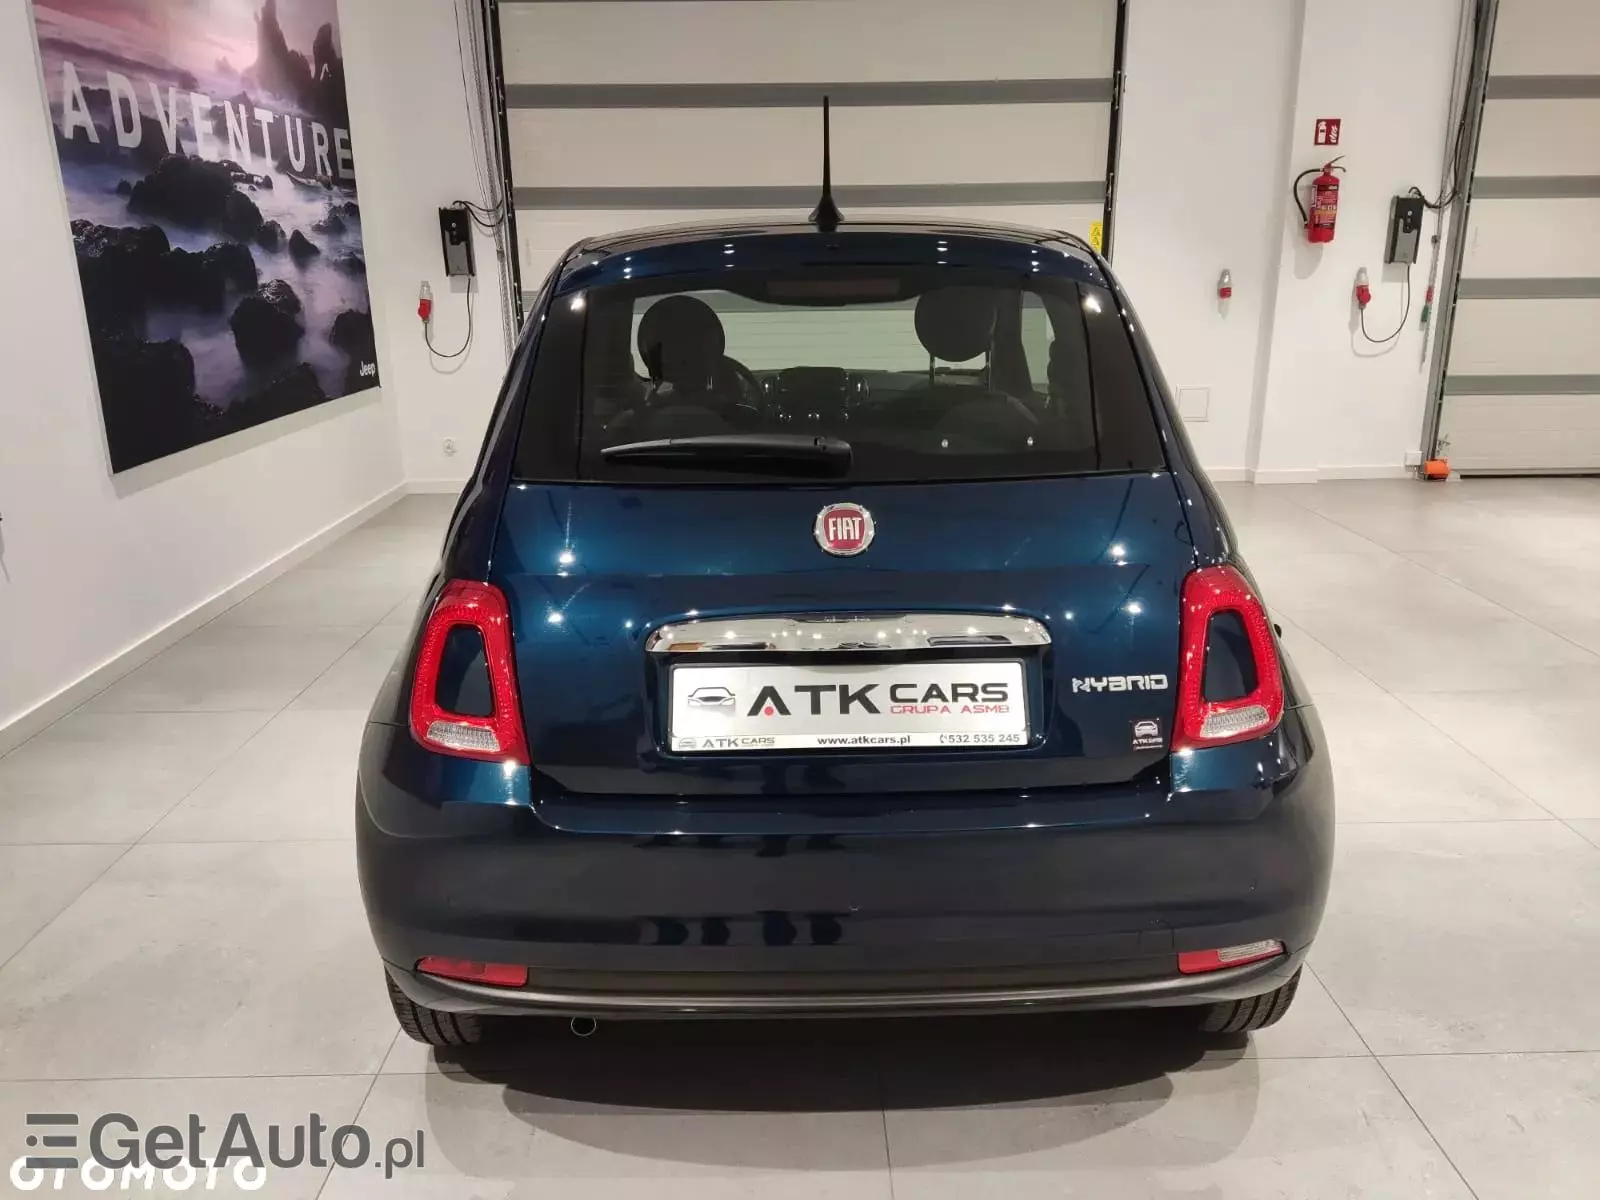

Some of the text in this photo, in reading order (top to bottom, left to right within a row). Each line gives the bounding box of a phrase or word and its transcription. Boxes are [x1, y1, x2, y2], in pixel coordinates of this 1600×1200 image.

[62, 61, 354, 180] ADVENTURE
[359, 360, 376, 377] Jeep
[828, 517, 862, 541] FIAT
[1071, 674, 1169, 693] HYBRID
[747, 682, 1009, 716] ATK CARS
[890, 704, 952, 714] GRUPA
[702, 737, 776, 748] ATK CARS
[817, 735, 911, 745] www.atkcars.pl
[948, 734, 1020, 743] 532 535 245
